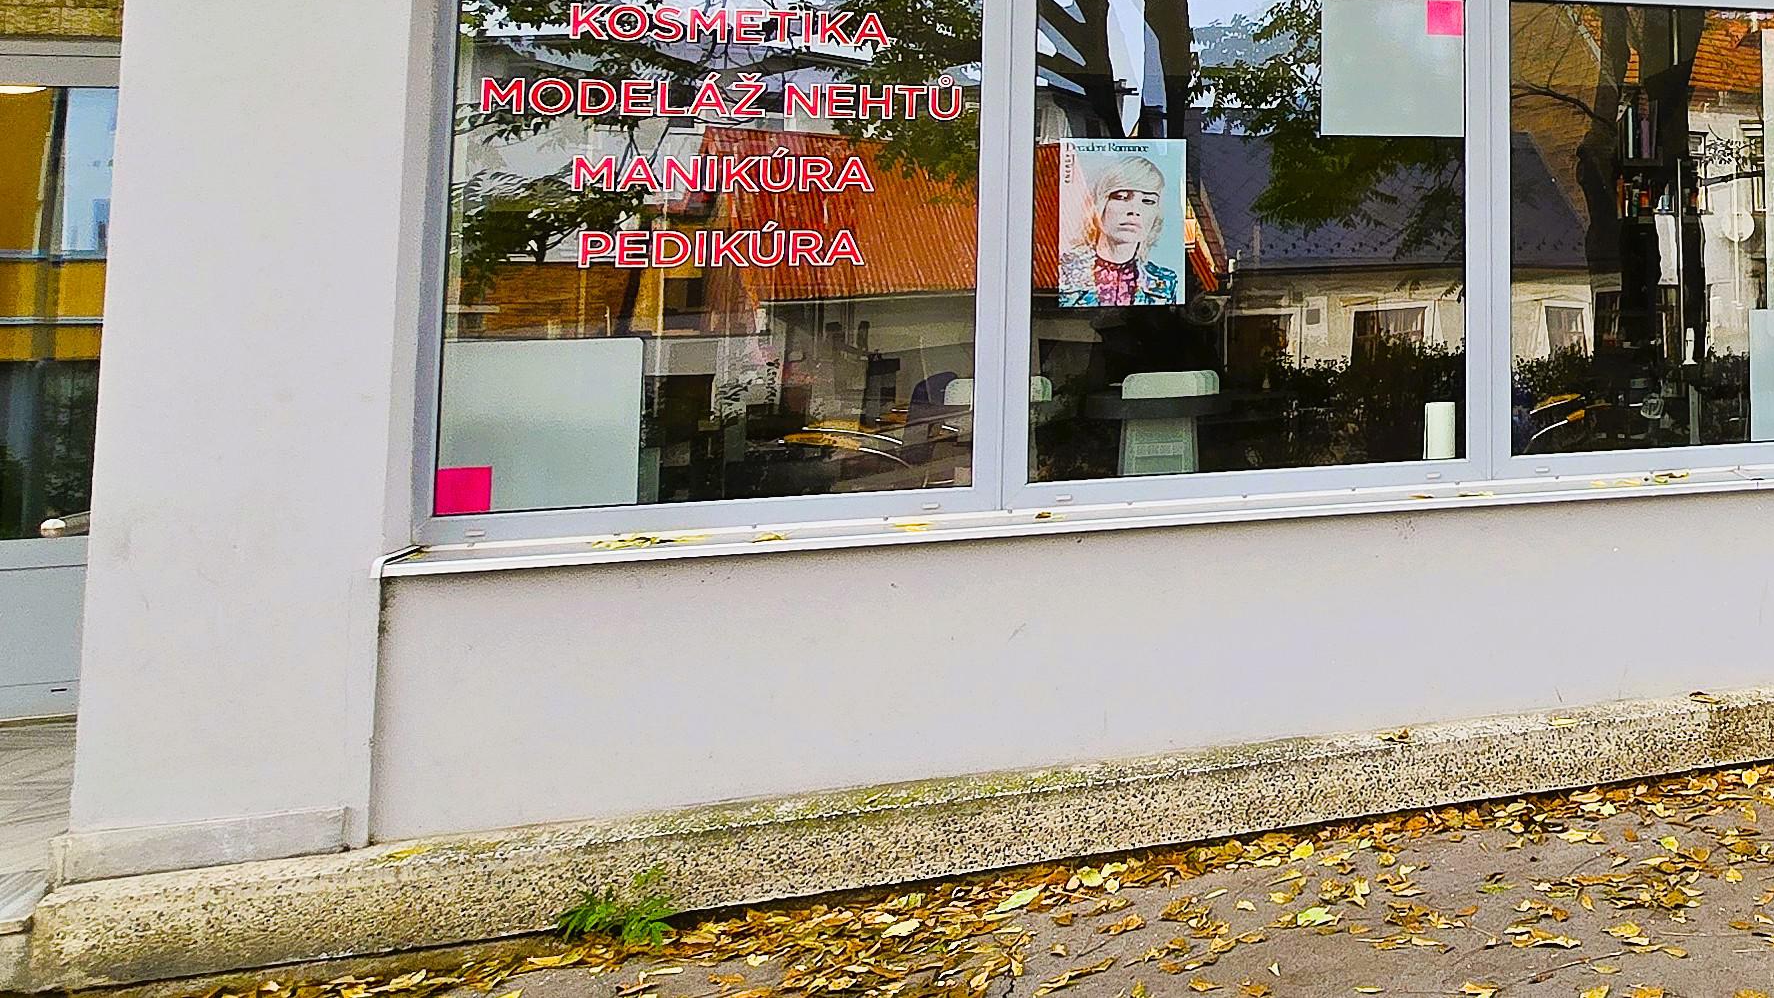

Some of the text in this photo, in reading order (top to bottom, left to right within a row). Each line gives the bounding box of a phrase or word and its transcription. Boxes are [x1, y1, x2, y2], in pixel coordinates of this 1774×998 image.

[569, 3, 891, 48] KOSMETIKA
[480, 73, 963, 121] MODELÁŽ NEHTŮ
[571, 147, 875, 193] MANIKÚRA
[577, 220, 865, 268] PEDIKÚRA
